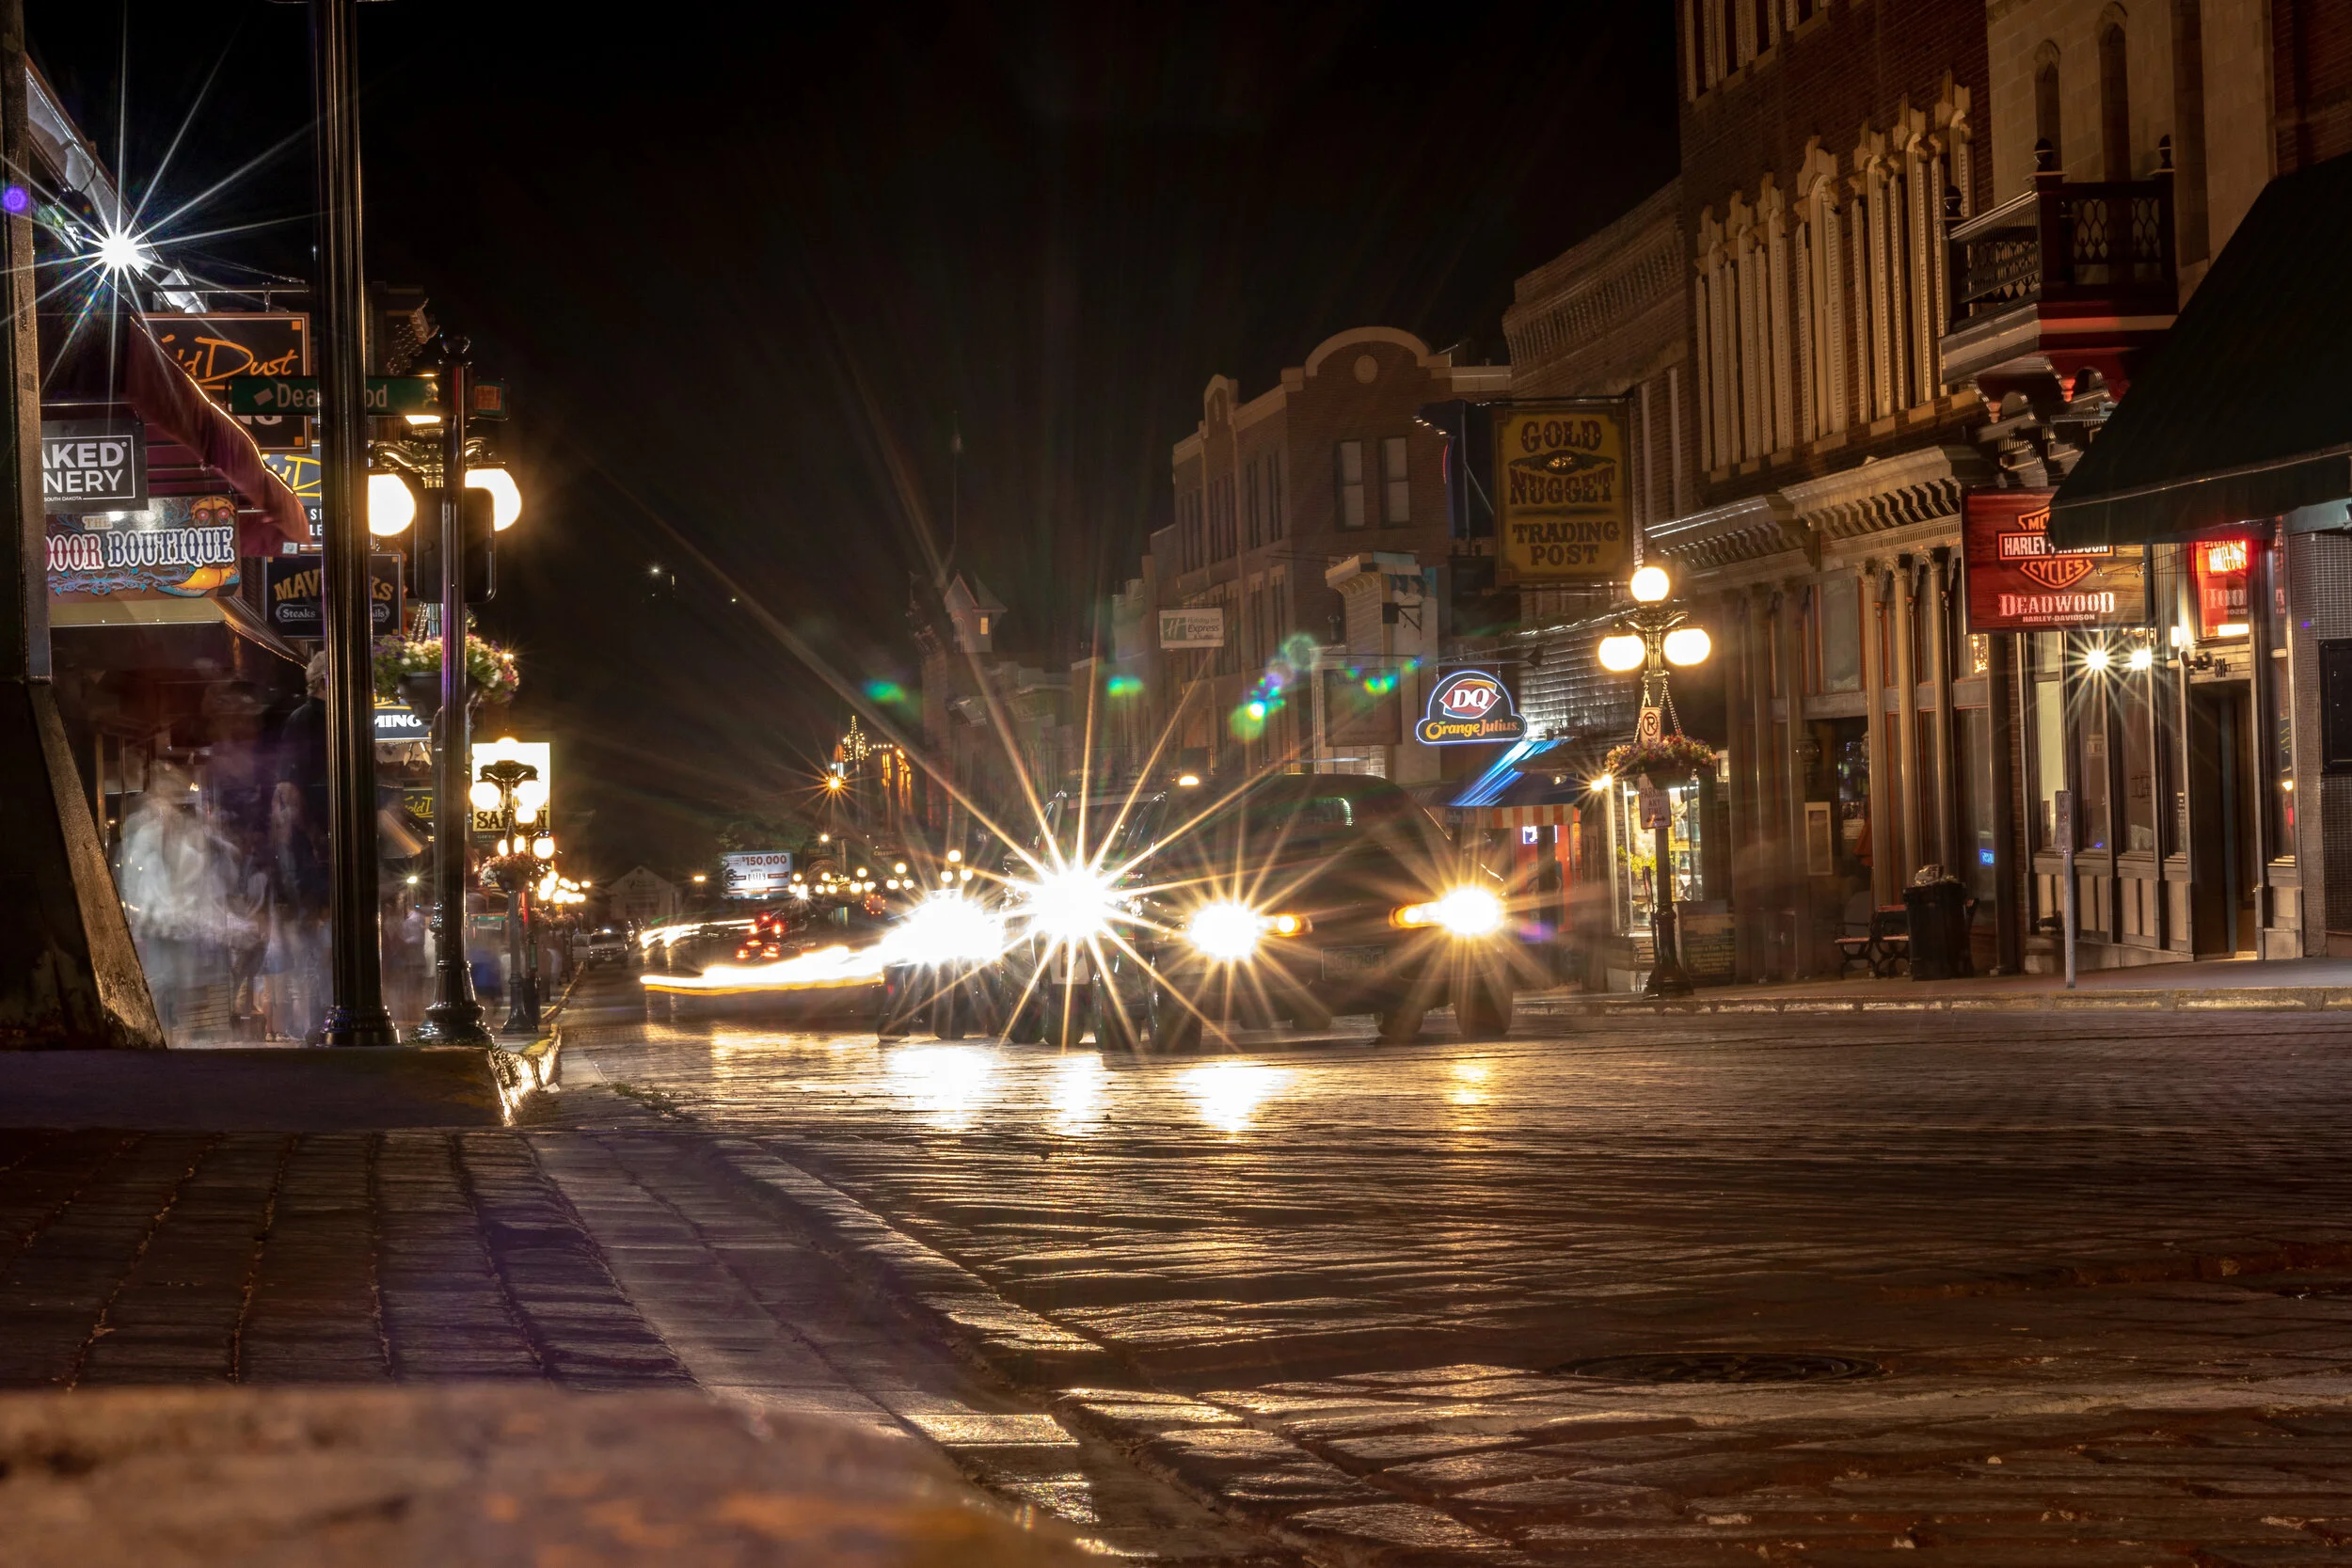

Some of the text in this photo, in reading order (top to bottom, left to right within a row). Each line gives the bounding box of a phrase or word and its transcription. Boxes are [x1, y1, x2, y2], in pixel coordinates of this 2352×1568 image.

[195, 336, 299, 383] Dust
[277, 383, 388, 408] Deaod
[1521, 420, 1602, 453] GOLD
[42, 442, 124, 469] KED
[43, 468, 124, 494] NERY
[1509, 466, 1615, 505] NUGGET
[85, 515, 113, 530] THE
[1512, 520, 1620, 545] TRADING
[108, 527, 235, 567] BOUTIQUE
[1530, 544, 1599, 566] POST
[2028, 560, 2085, 585] CYCLES
[282, 608, 316, 619] Steaks
[1997, 592, 2116, 617] DEADWOOD
[1187, 624, 1220, 634] Express
[2022, 613, 2096, 623] HARLEY-DAVIDSON
[1451, 688, 1490, 710] DQ
[373, 713, 423, 729] MING
[1425, 721, 1481, 740] Orange
[476, 810, 548, 829] SAN
[741, 855, 787, 866] $150,000
